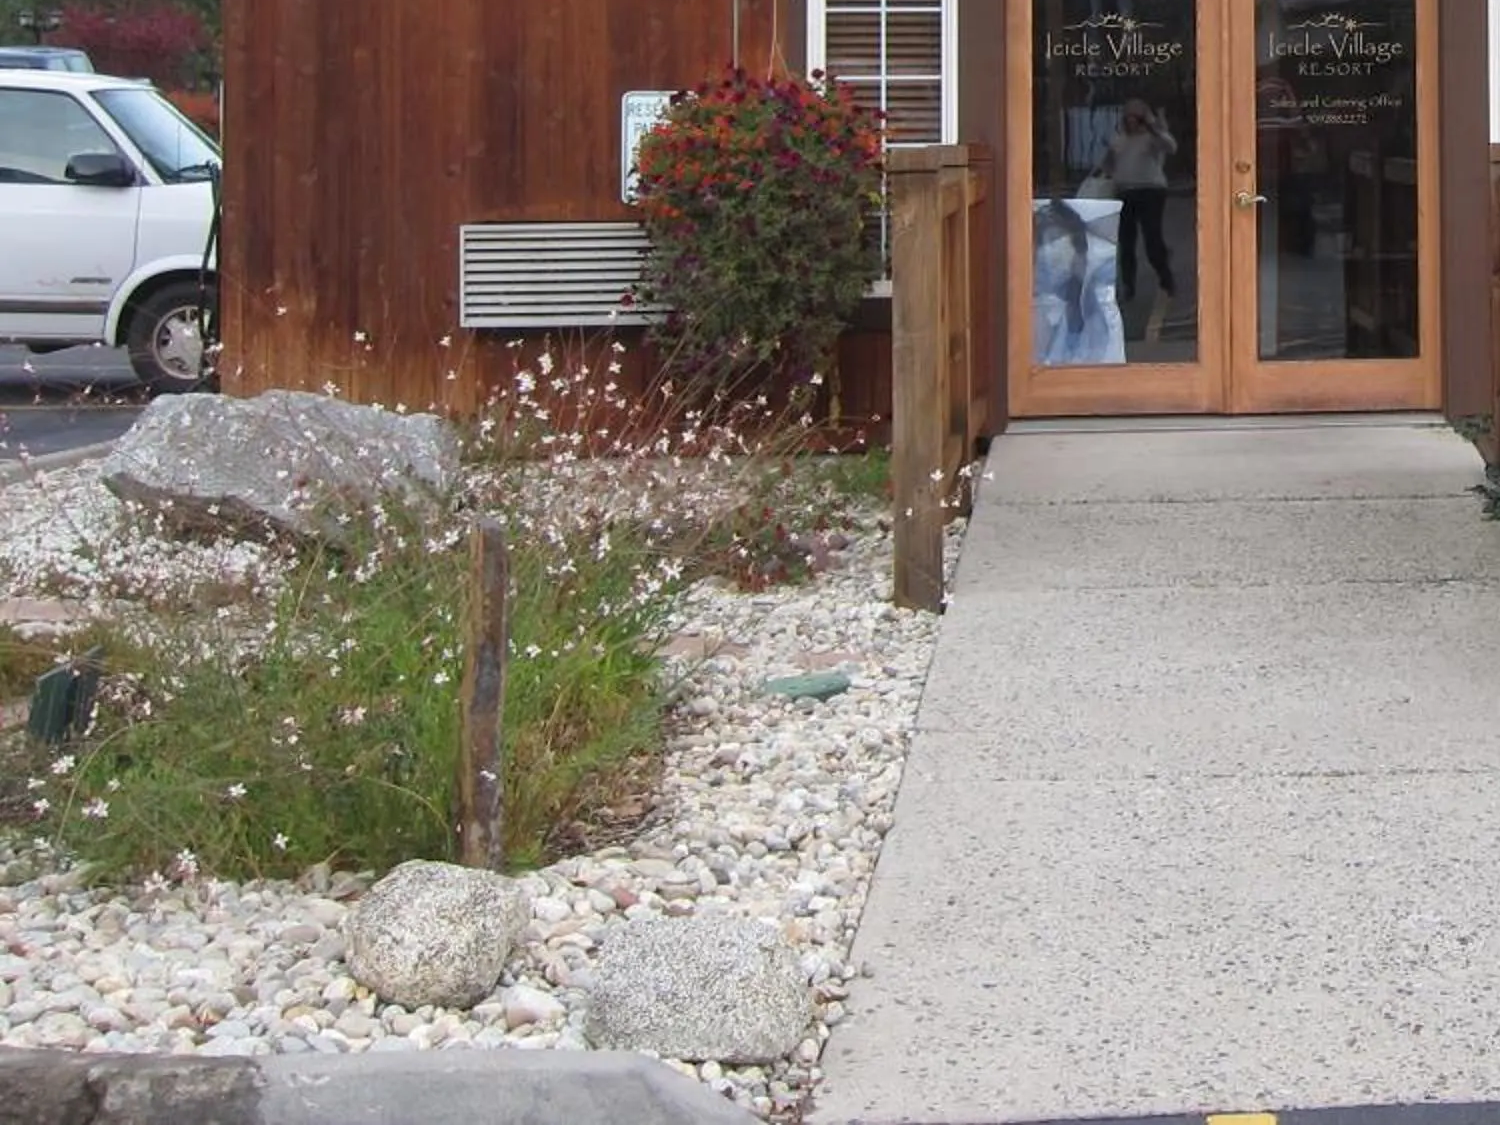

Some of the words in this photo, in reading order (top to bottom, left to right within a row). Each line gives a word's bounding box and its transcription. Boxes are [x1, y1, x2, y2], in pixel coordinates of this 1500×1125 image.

[1046, 31, 1101, 60] Icicle
[1106, 31, 1183, 64] Village
[1268, 31, 1325, 59] Icicle
[1328, 31, 1403, 63] Village
[1075, 62, 1154, 76] RESORT
[1298, 62, 1376, 76] RESORT
[1300, 94, 1319, 108] and
